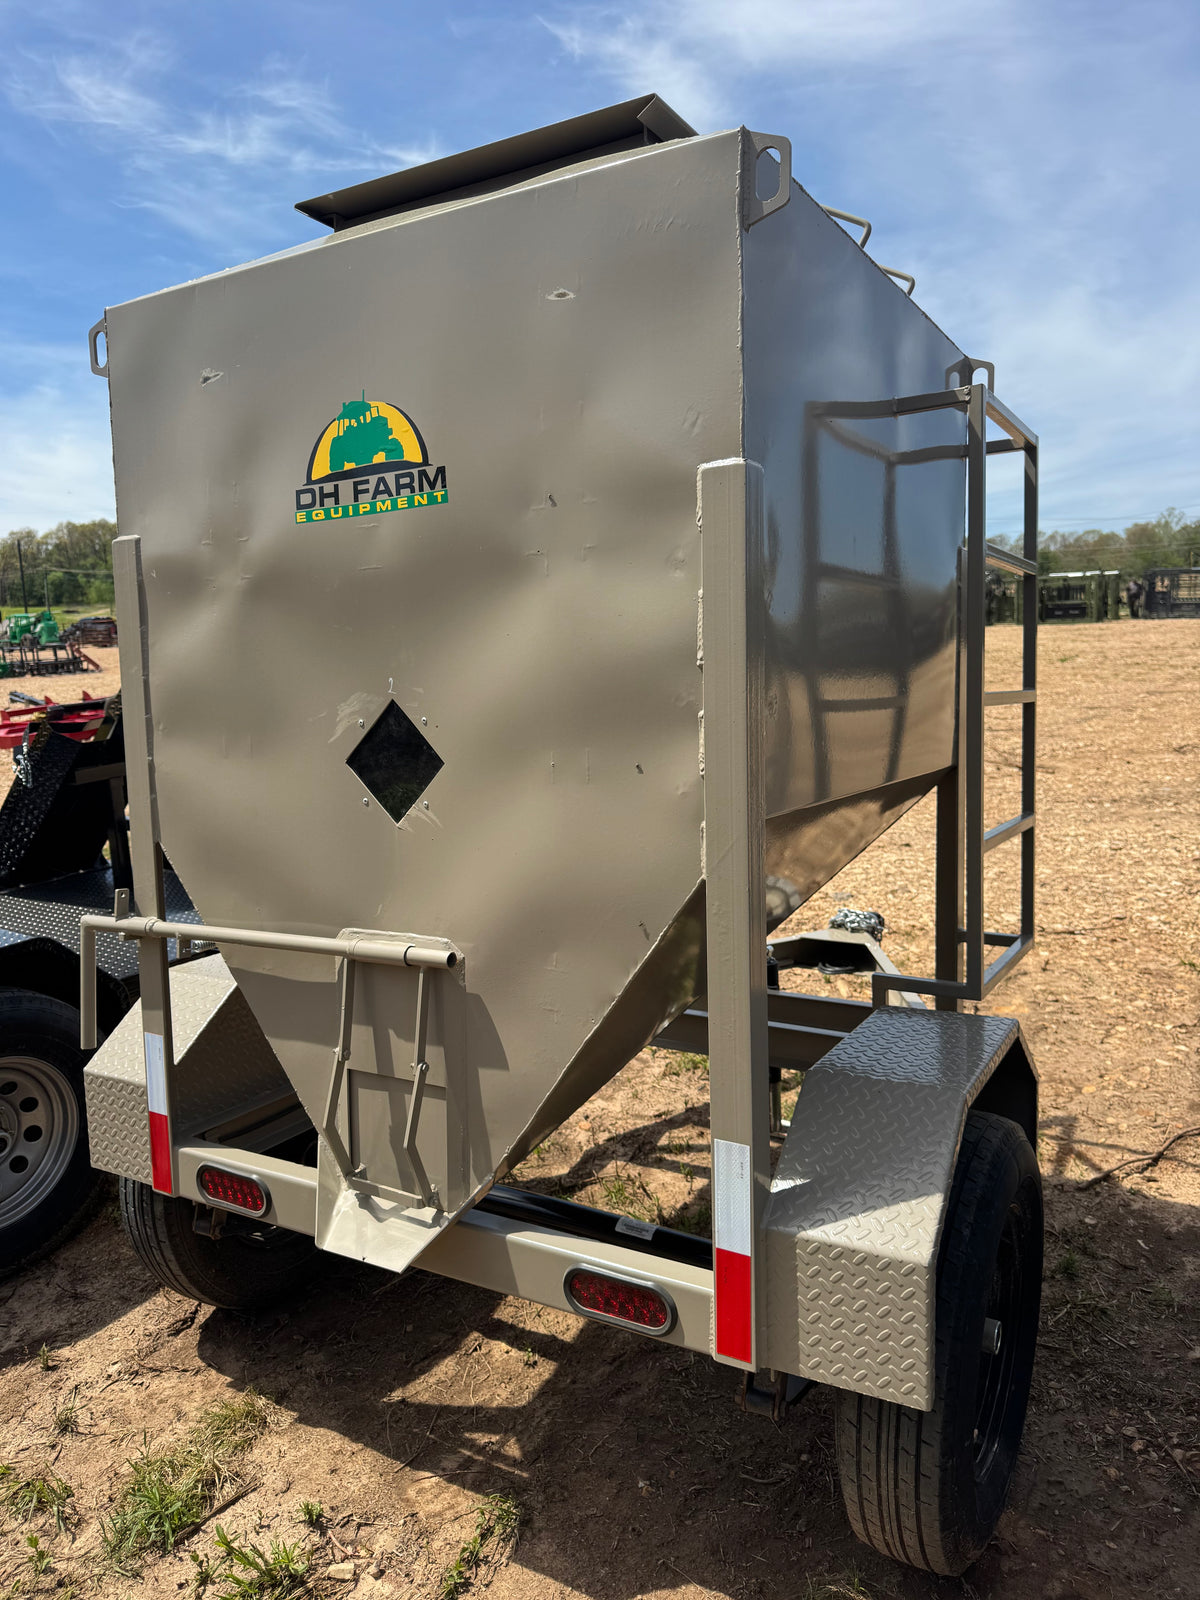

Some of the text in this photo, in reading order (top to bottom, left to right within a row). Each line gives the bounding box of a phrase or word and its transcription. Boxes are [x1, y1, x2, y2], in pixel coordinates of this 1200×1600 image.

[295, 465, 447, 511] DH FARM
[296, 491, 446, 523] EQUIPMENT
